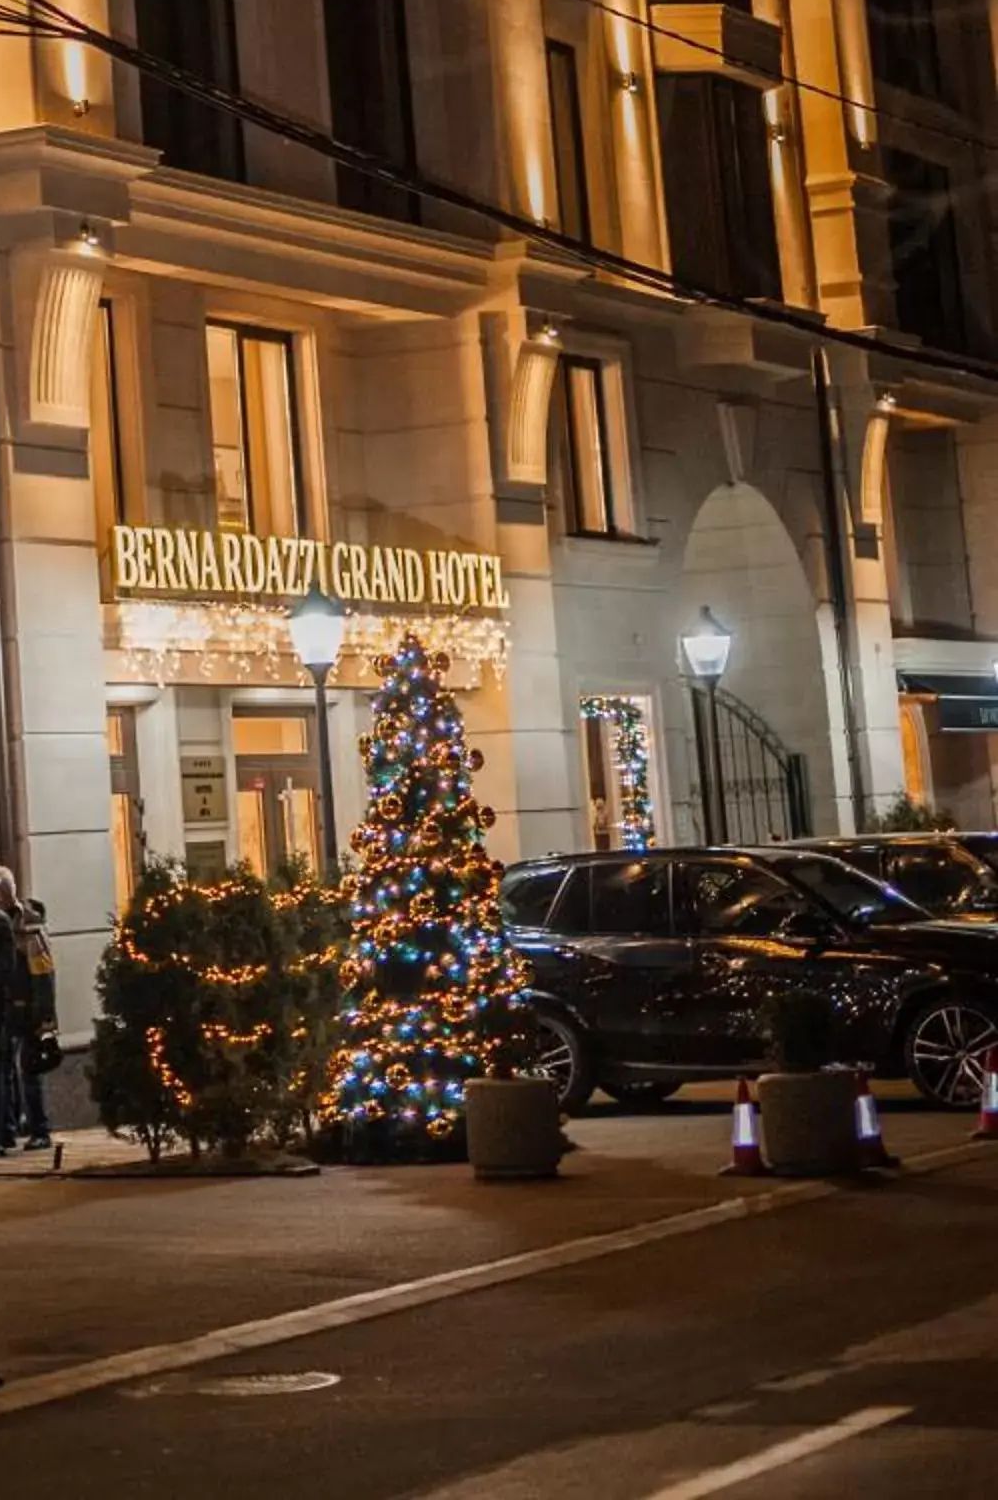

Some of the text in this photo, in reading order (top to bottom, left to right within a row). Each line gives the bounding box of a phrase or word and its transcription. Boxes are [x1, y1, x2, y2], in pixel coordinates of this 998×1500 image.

[114, 525, 510, 609] BERNARDAZZI GRAND HOTEL
